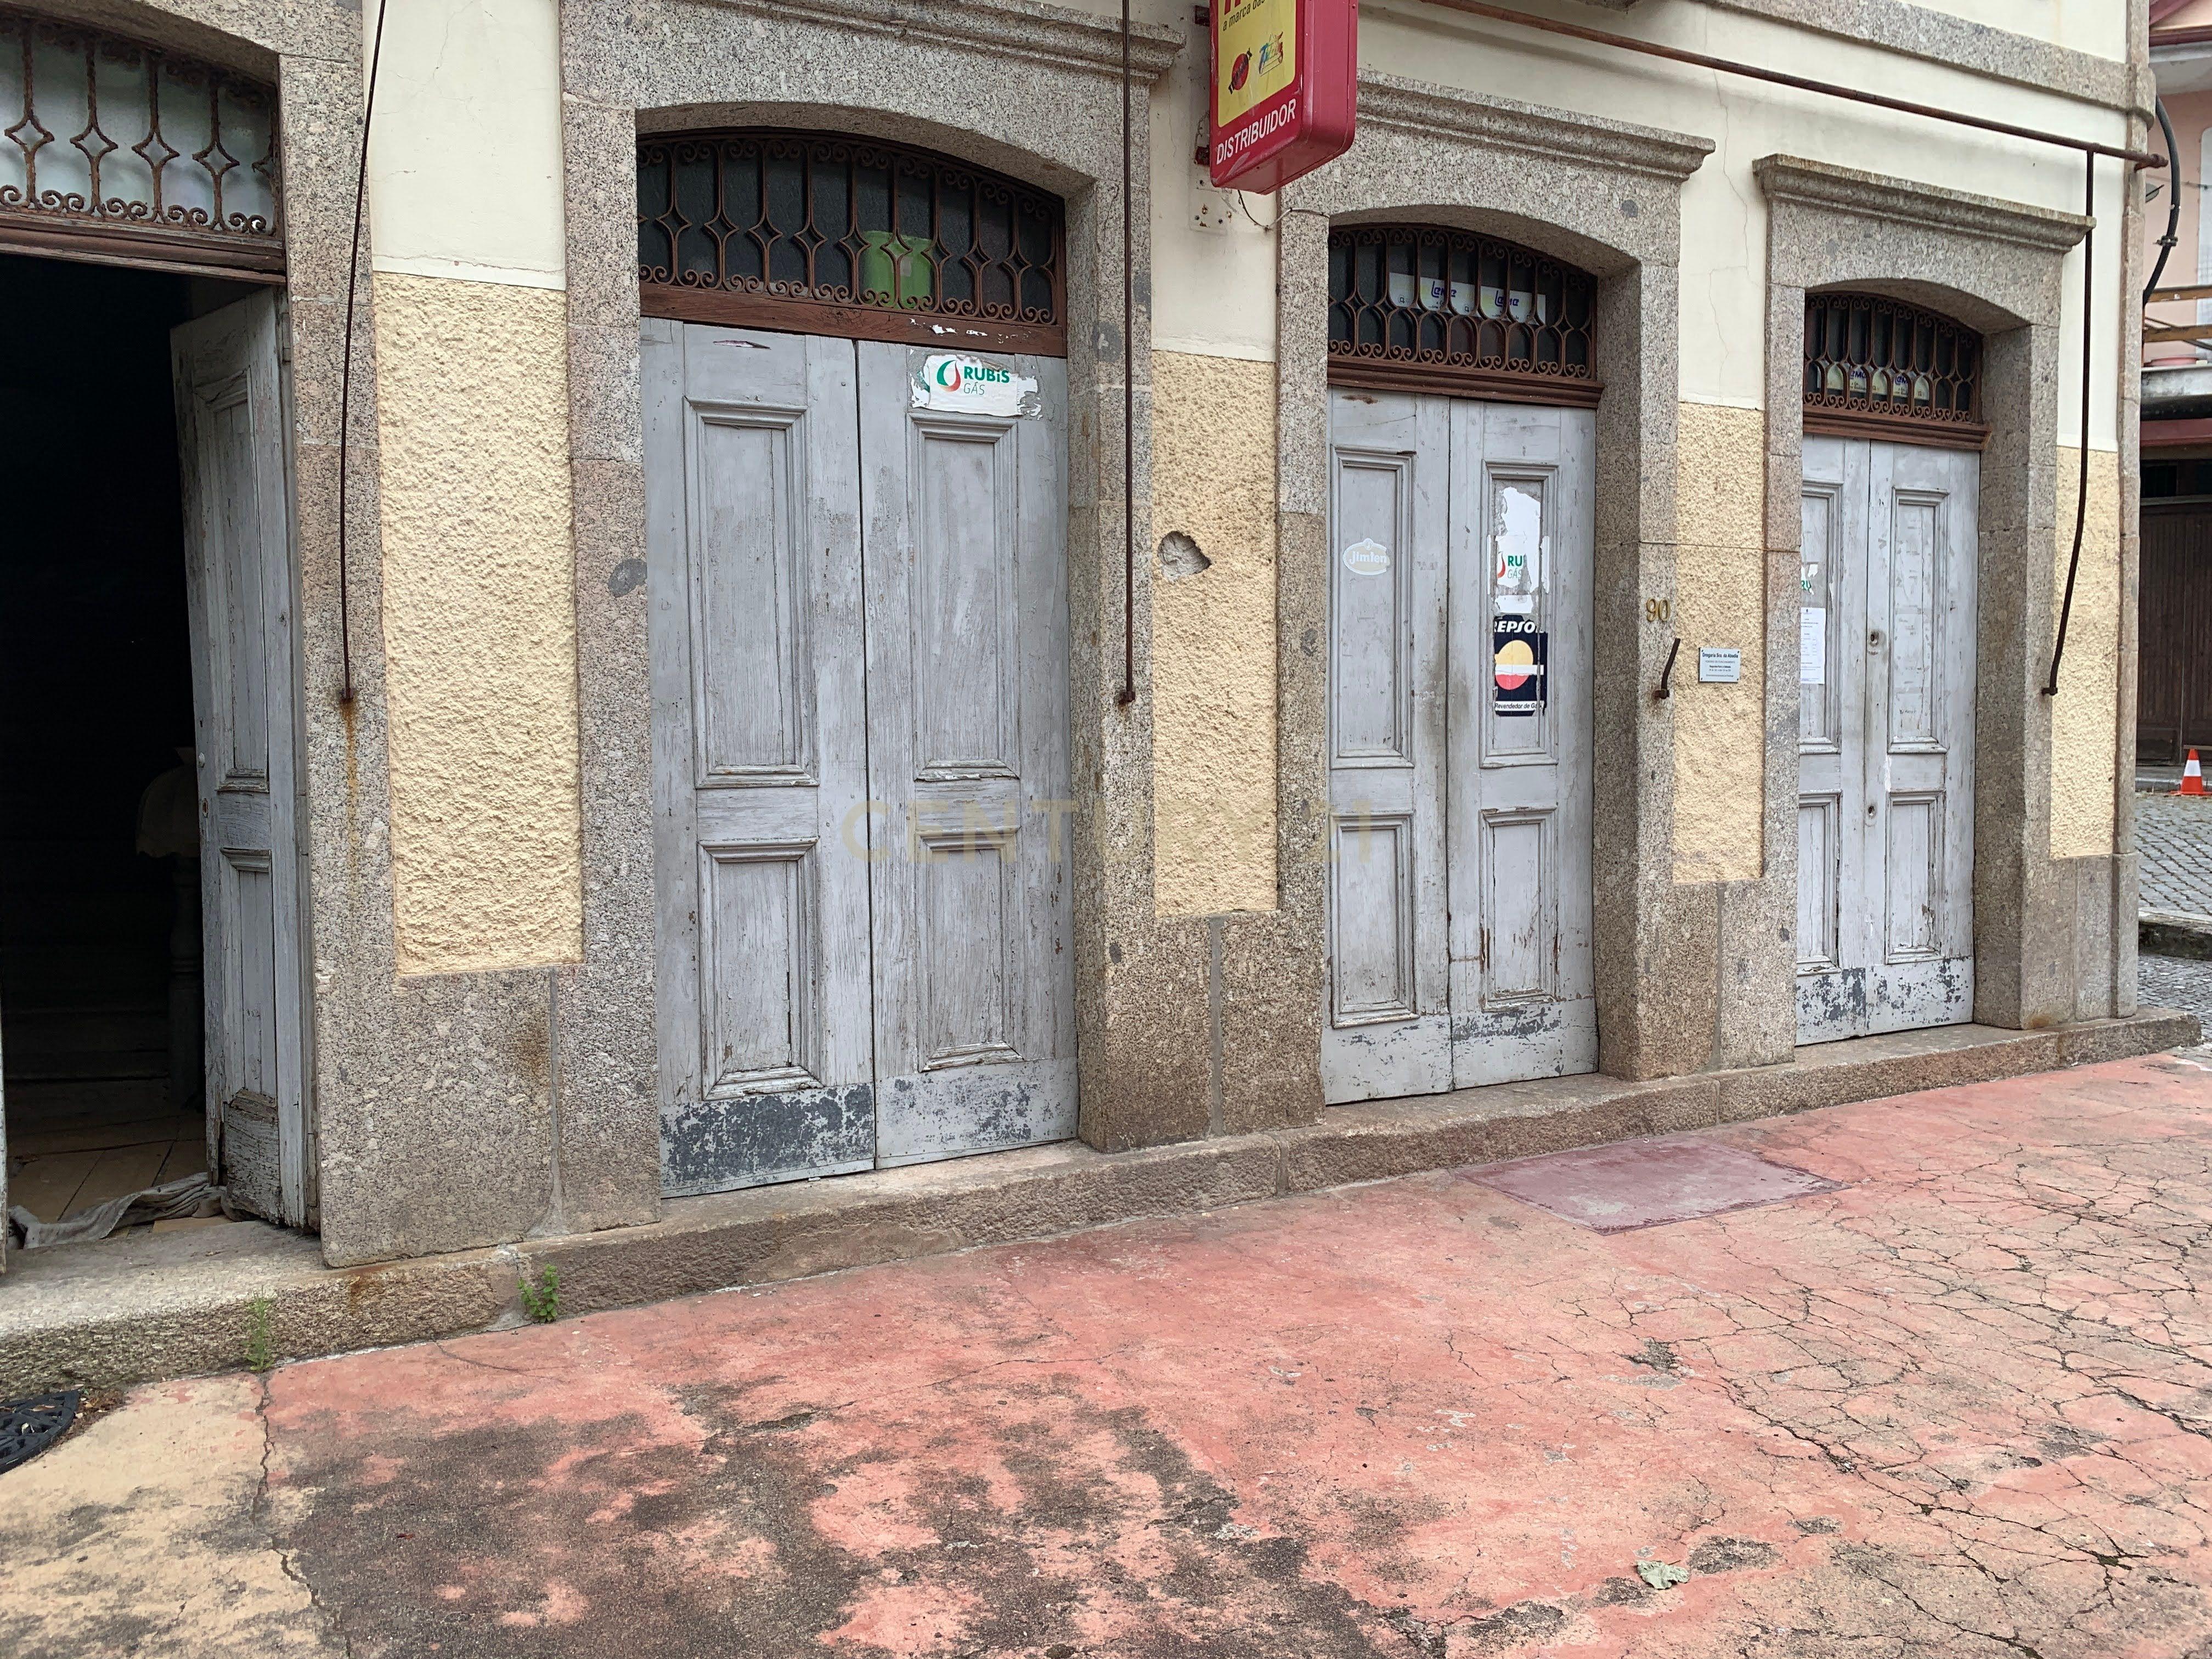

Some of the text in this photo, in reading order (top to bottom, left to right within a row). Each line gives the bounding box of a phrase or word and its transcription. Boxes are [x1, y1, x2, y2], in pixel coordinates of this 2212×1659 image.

[1228, 3, 1251, 29] marca
[1216, 98, 1297, 165] DISTRIBUIDOR
[963, 382, 985, 396] GÁS
[1645, 598, 1671, 623] 90
